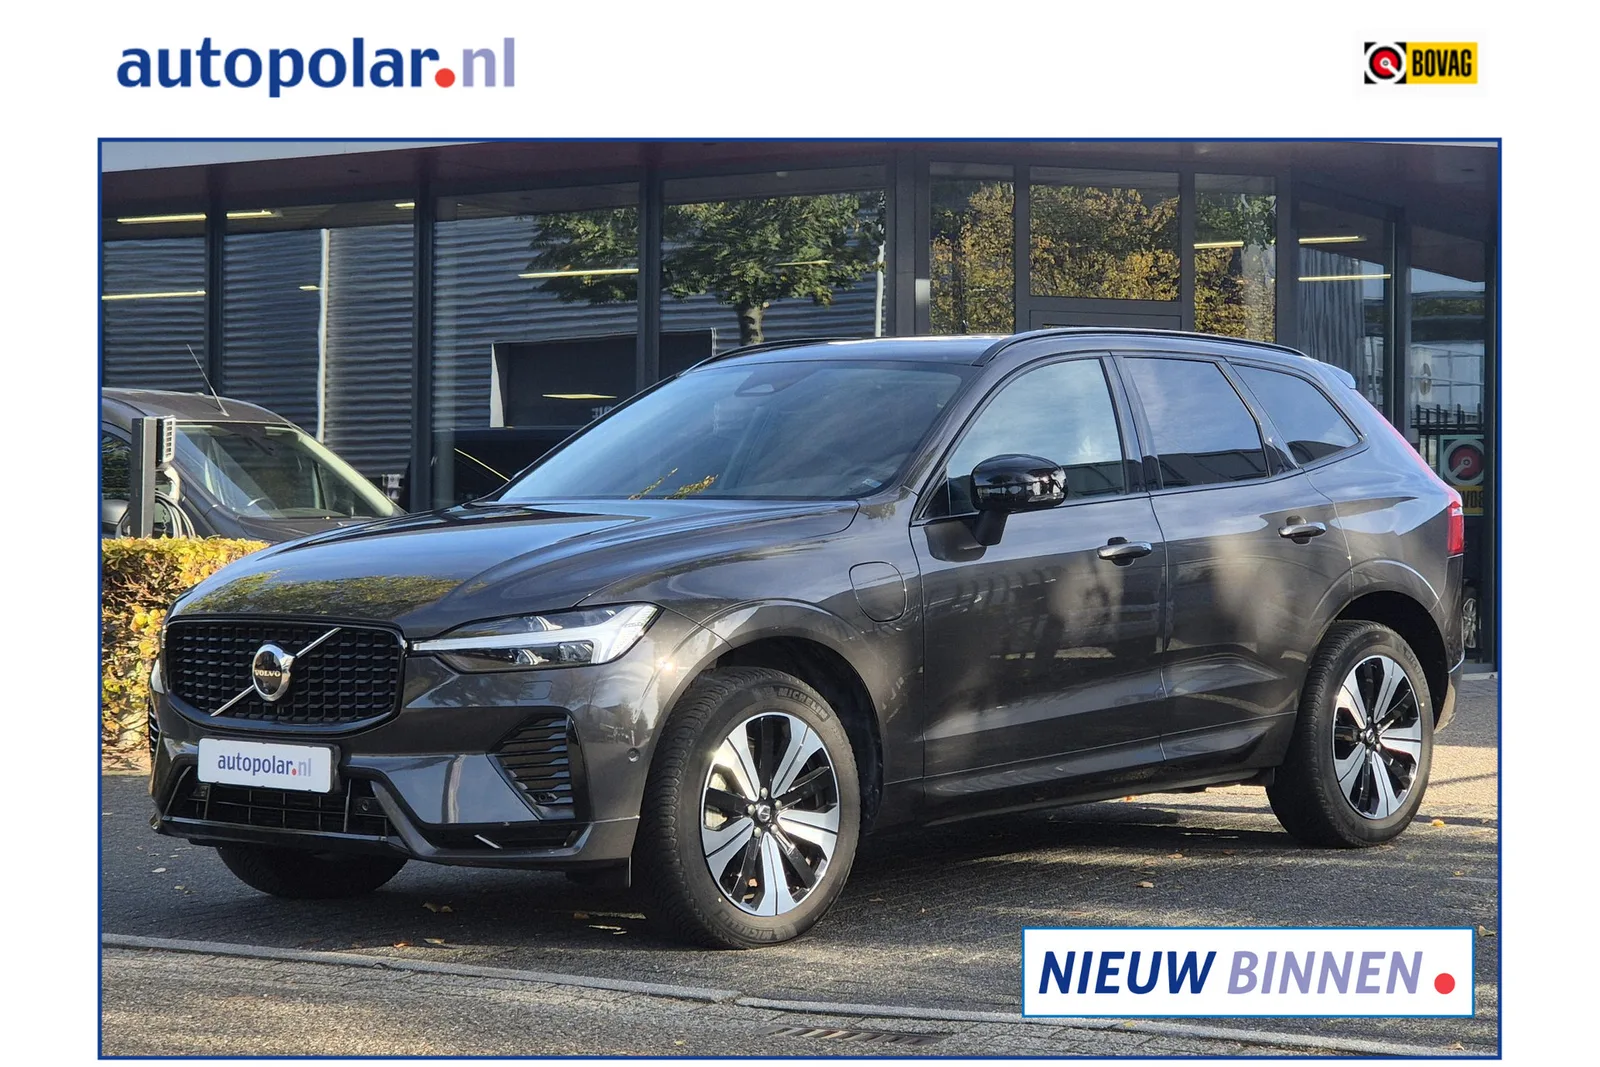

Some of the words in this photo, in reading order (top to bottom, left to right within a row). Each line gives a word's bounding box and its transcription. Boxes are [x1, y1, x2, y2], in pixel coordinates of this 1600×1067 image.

[254, 669, 281, 677] VOLVO
[777, 687, 829, 720] MICHELIN
[218, 752, 312, 777] autopolar.nl
